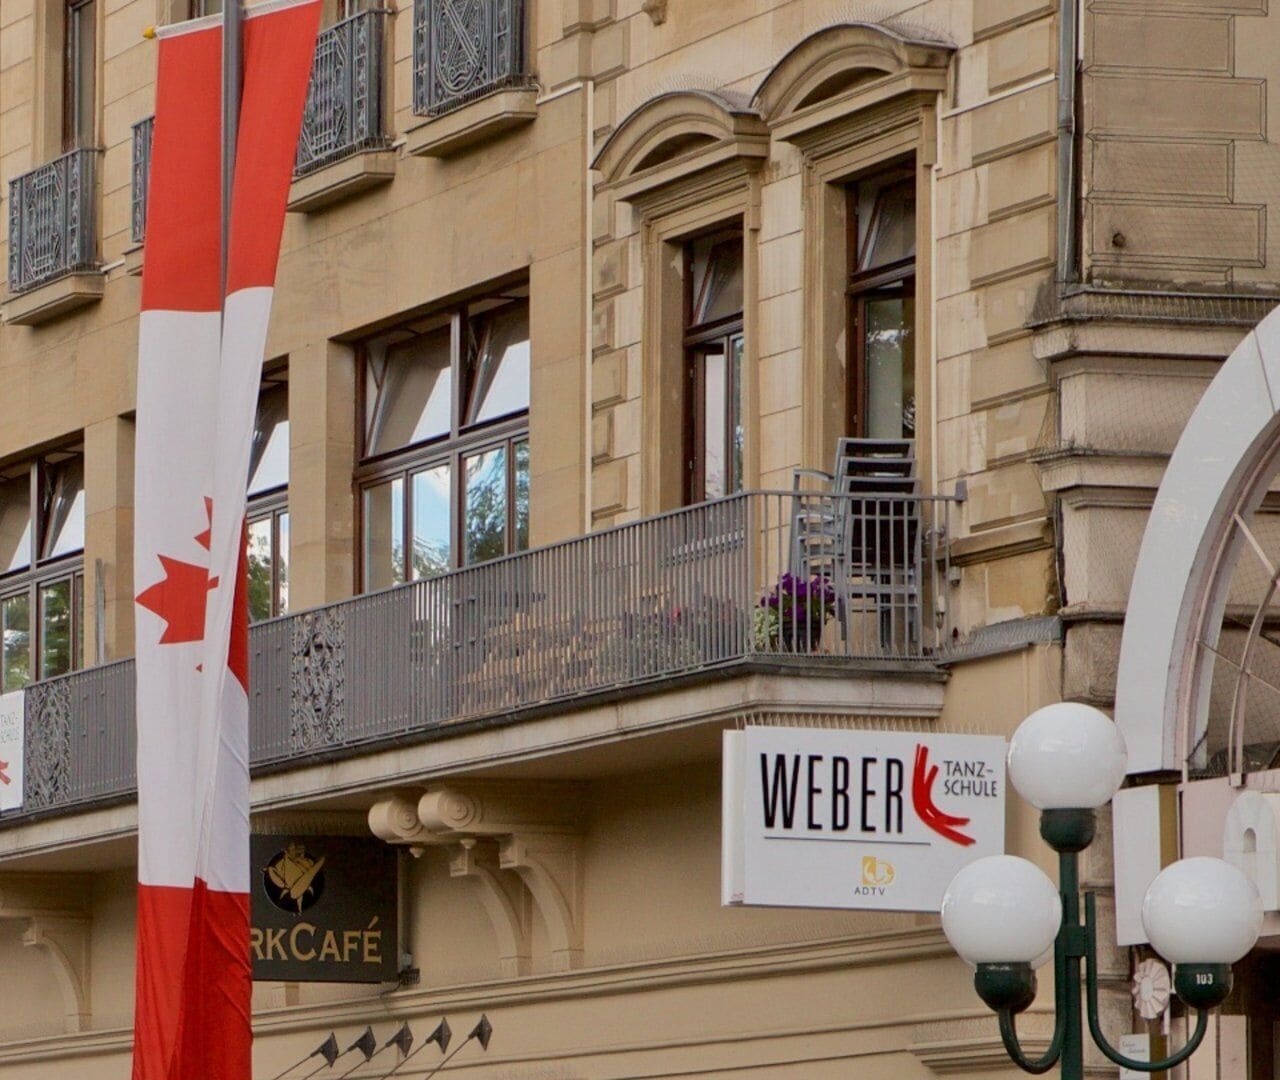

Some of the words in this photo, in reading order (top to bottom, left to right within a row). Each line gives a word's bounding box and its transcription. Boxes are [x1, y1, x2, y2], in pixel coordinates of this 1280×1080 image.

[943, 760, 994, 778] TANZ-
[760, 753, 904, 834] WEBER
[944, 780, 998, 797] SCHULE
[854, 886, 886, 896] ADTV
[1195, 972, 1214, 986] 103
